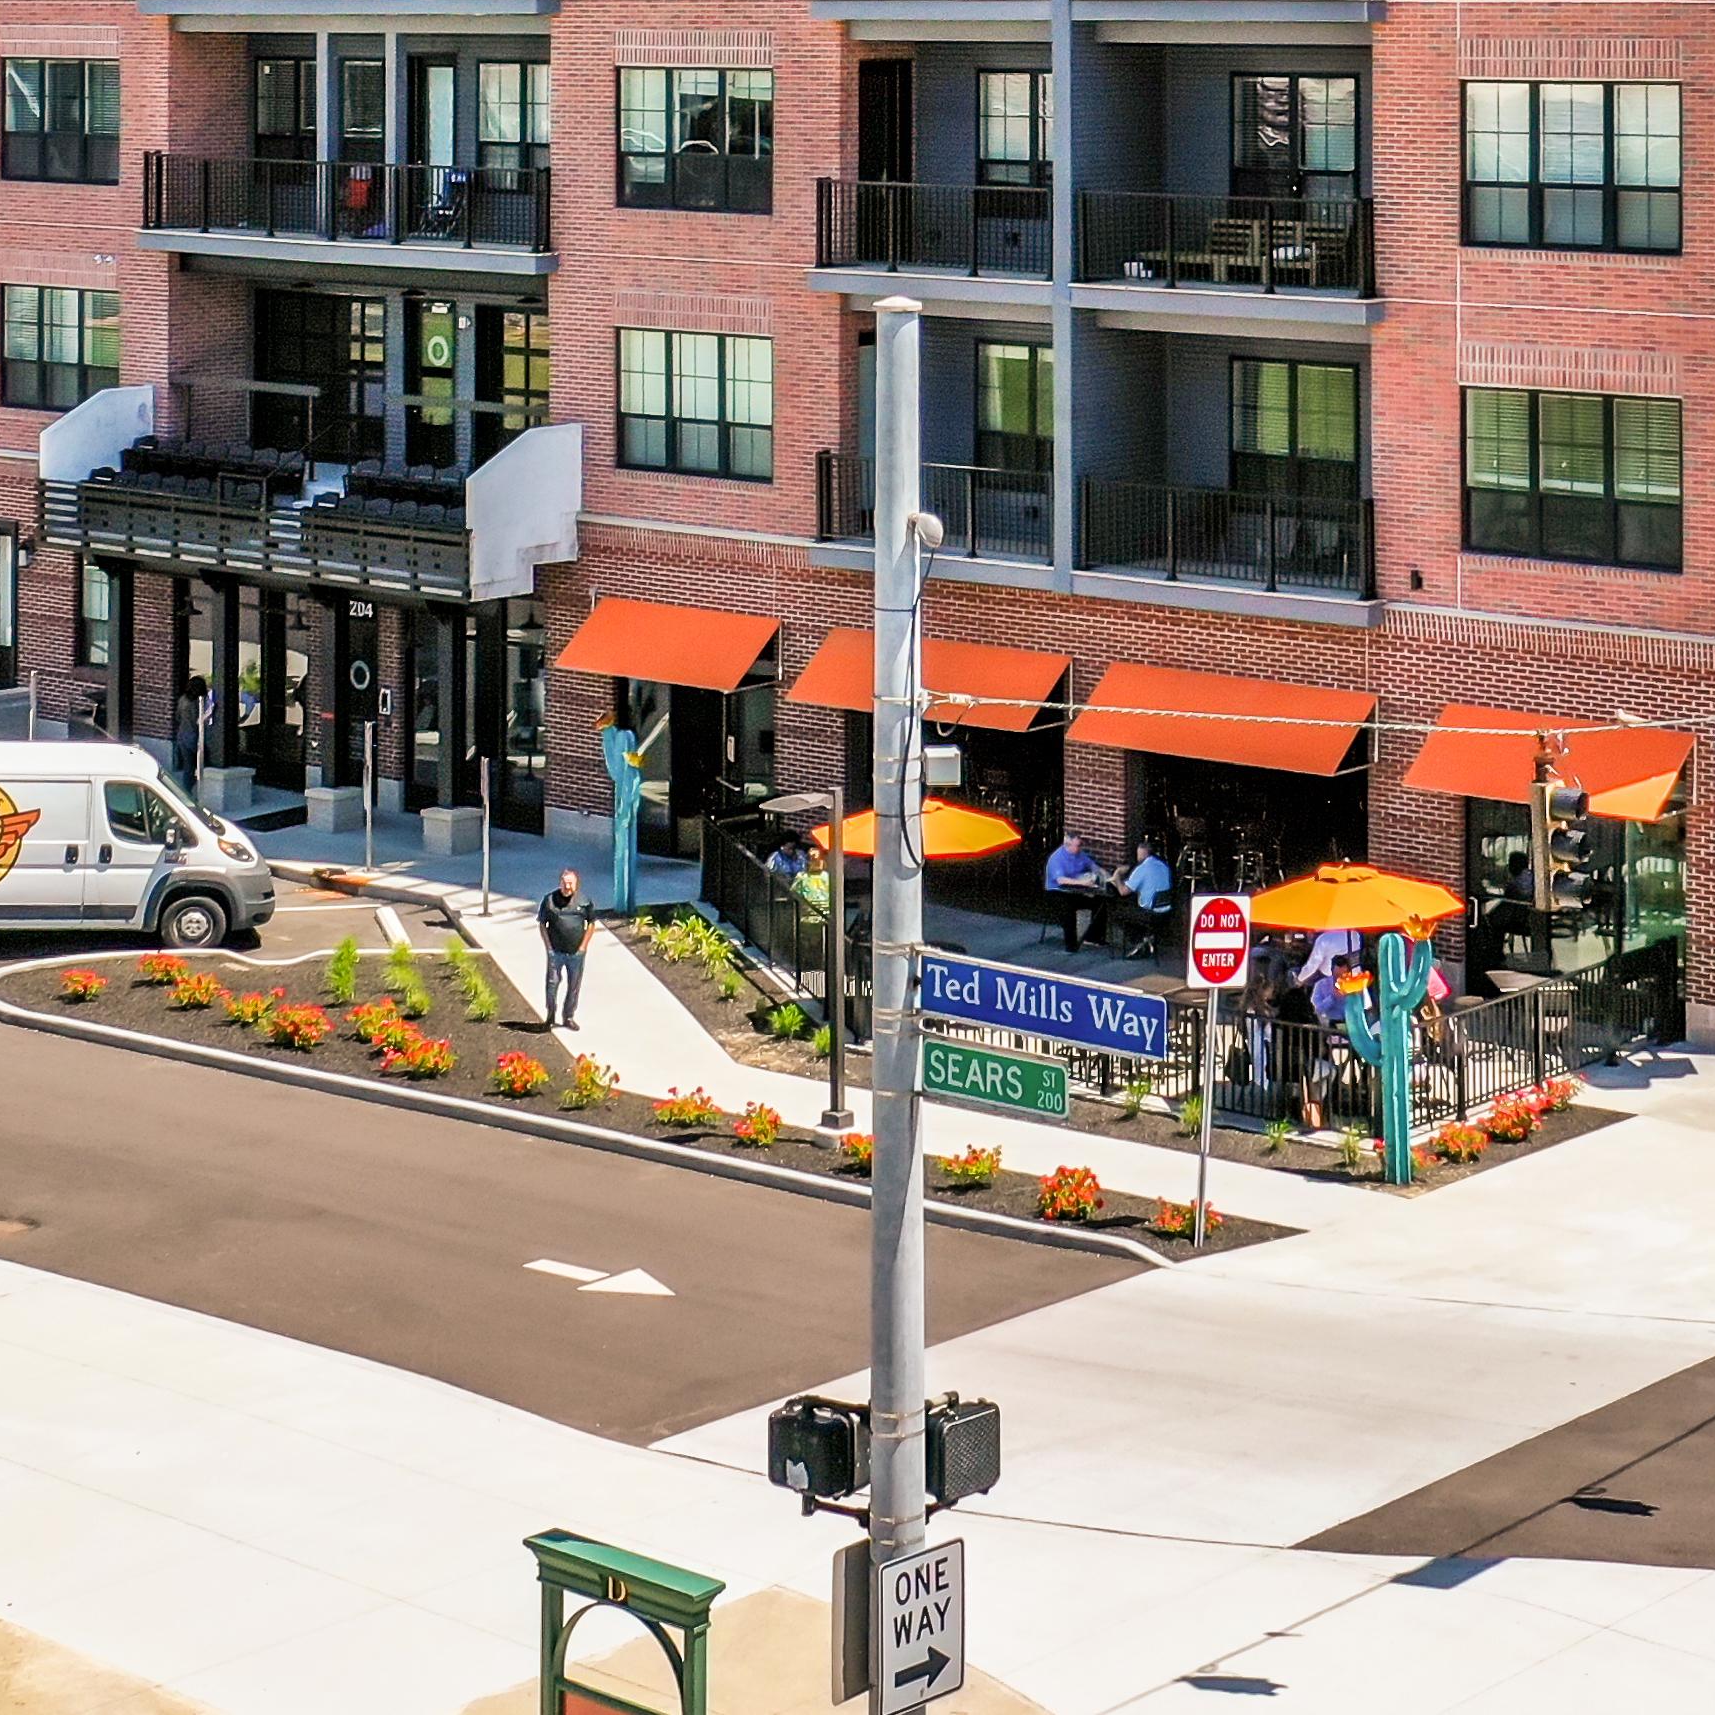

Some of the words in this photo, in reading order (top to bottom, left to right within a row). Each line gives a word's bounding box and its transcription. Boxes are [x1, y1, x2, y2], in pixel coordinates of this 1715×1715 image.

[349, 600, 373, 618] 204
[1201, 913, 1215, 928] DO
[1220, 913, 1241, 928] NOT
[1201, 953, 1235, 967] ENTER
[926, 963, 981, 1005] Ted
[995, 976, 1073, 1023] Mills
[1087, 993, 1159, 1051] Way
[929, 1049, 1024, 1100] SEARS
[1042, 1070, 1056, 1089] ST
[1037, 1091, 1063, 1112] 200
[895, 1556, 950, 1606] ONE
[893, 1596, 952, 1649] WAY
